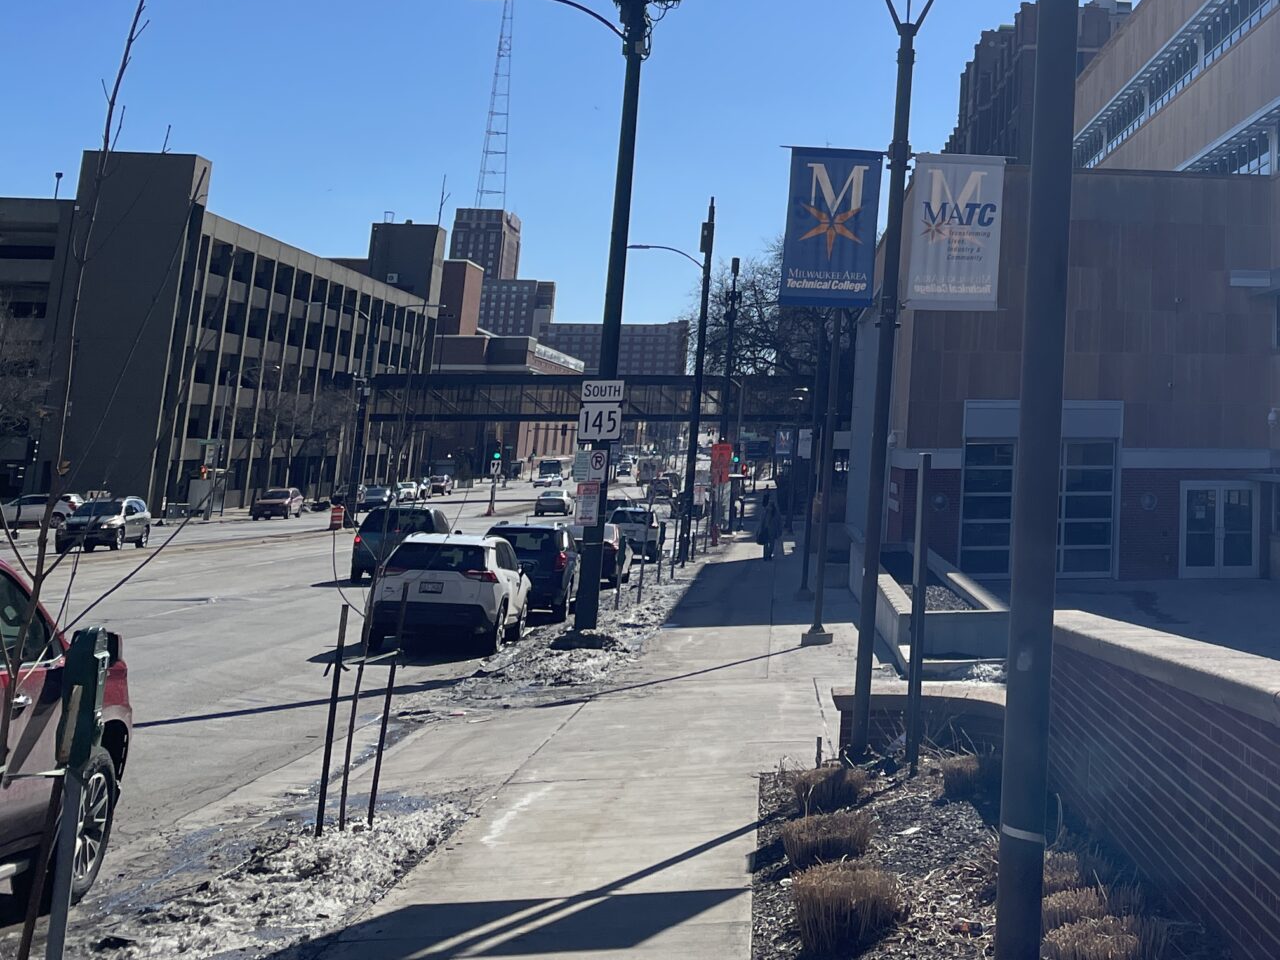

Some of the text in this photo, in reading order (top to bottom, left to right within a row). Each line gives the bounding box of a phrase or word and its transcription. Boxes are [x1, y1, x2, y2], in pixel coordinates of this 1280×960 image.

[807, 163, 870, 217] M
[922, 201, 997, 227] MATC
[788, 267, 867, 281] MILWAUKEE AREA
[786, 278, 867, 293] Technical College
[584, 383, 622, 398] SOUTH
[584, 410, 617, 435] 145
